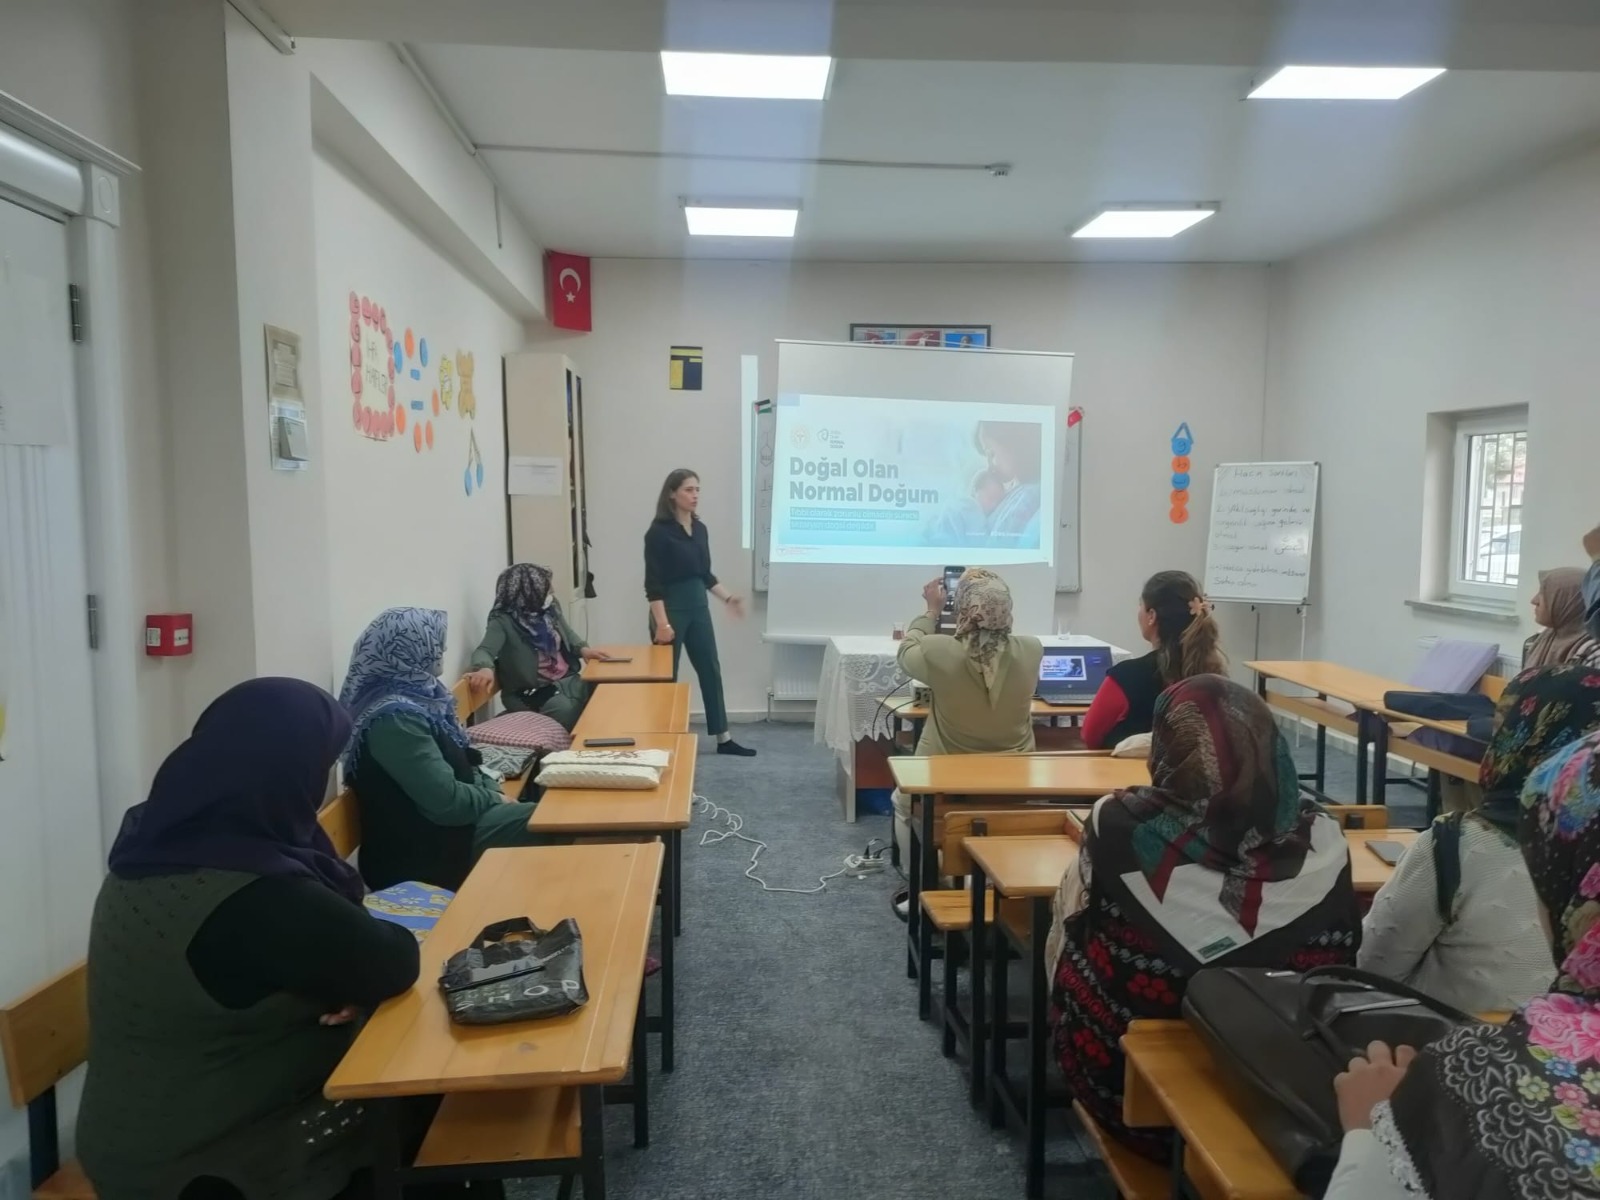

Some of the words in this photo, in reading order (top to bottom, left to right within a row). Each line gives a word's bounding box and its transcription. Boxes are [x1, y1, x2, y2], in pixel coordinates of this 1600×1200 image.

[790, 456, 847, 481] Doğal
[853, 458, 899, 478] Olan
[790, 481, 863, 501] Normal
[868, 483, 939, 508] Doğum
